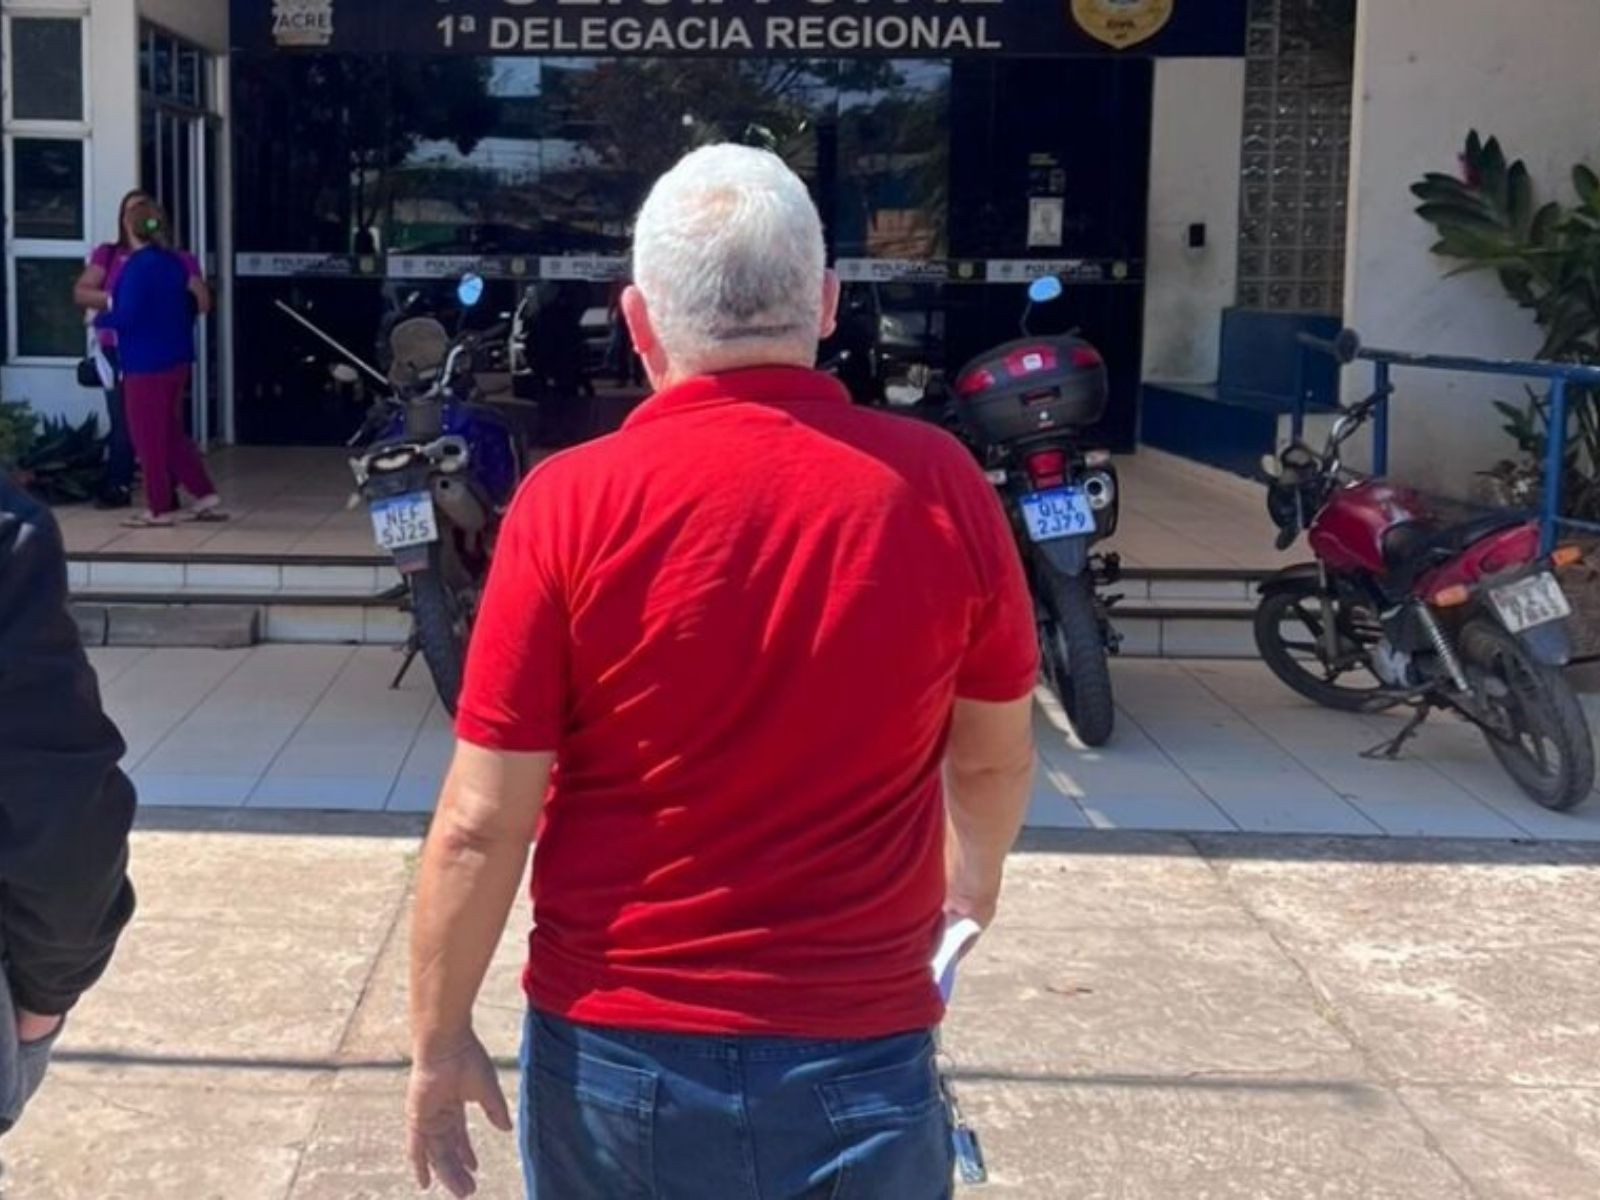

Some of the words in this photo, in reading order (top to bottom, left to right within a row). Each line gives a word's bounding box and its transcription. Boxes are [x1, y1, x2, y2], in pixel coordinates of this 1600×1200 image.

[277, 12, 328, 29] ACRE
[437, 15, 476, 47] 1ª
[489, 17, 753, 49] DELEGACIA
[766, 16, 1001, 48] REGIONAL
